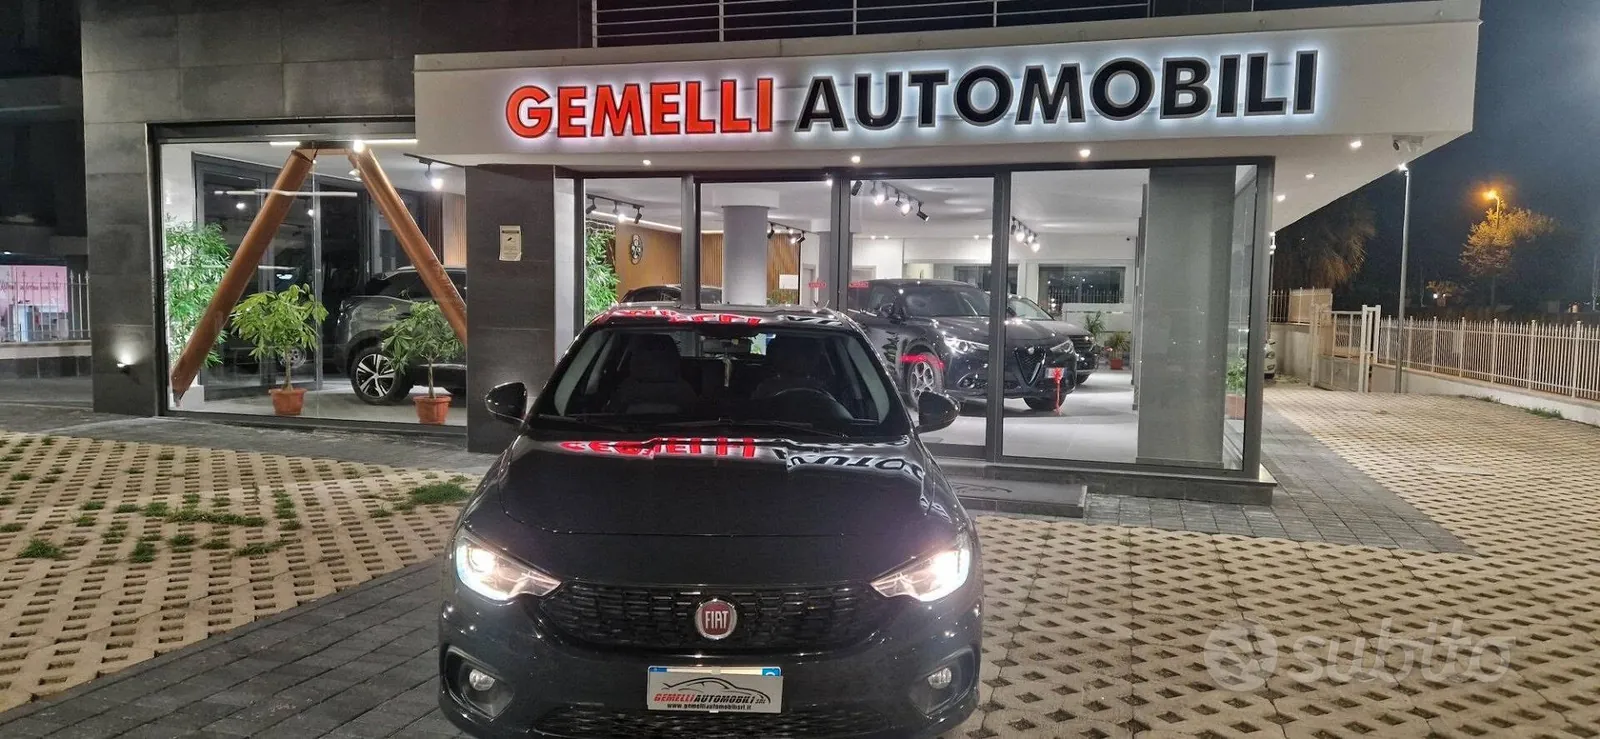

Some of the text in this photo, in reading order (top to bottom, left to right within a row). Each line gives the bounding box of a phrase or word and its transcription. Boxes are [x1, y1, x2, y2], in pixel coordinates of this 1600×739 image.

[505, 49, 1319, 139] GEMELLI AUTOMOBILI
[705, 610, 729, 629] FIAT
